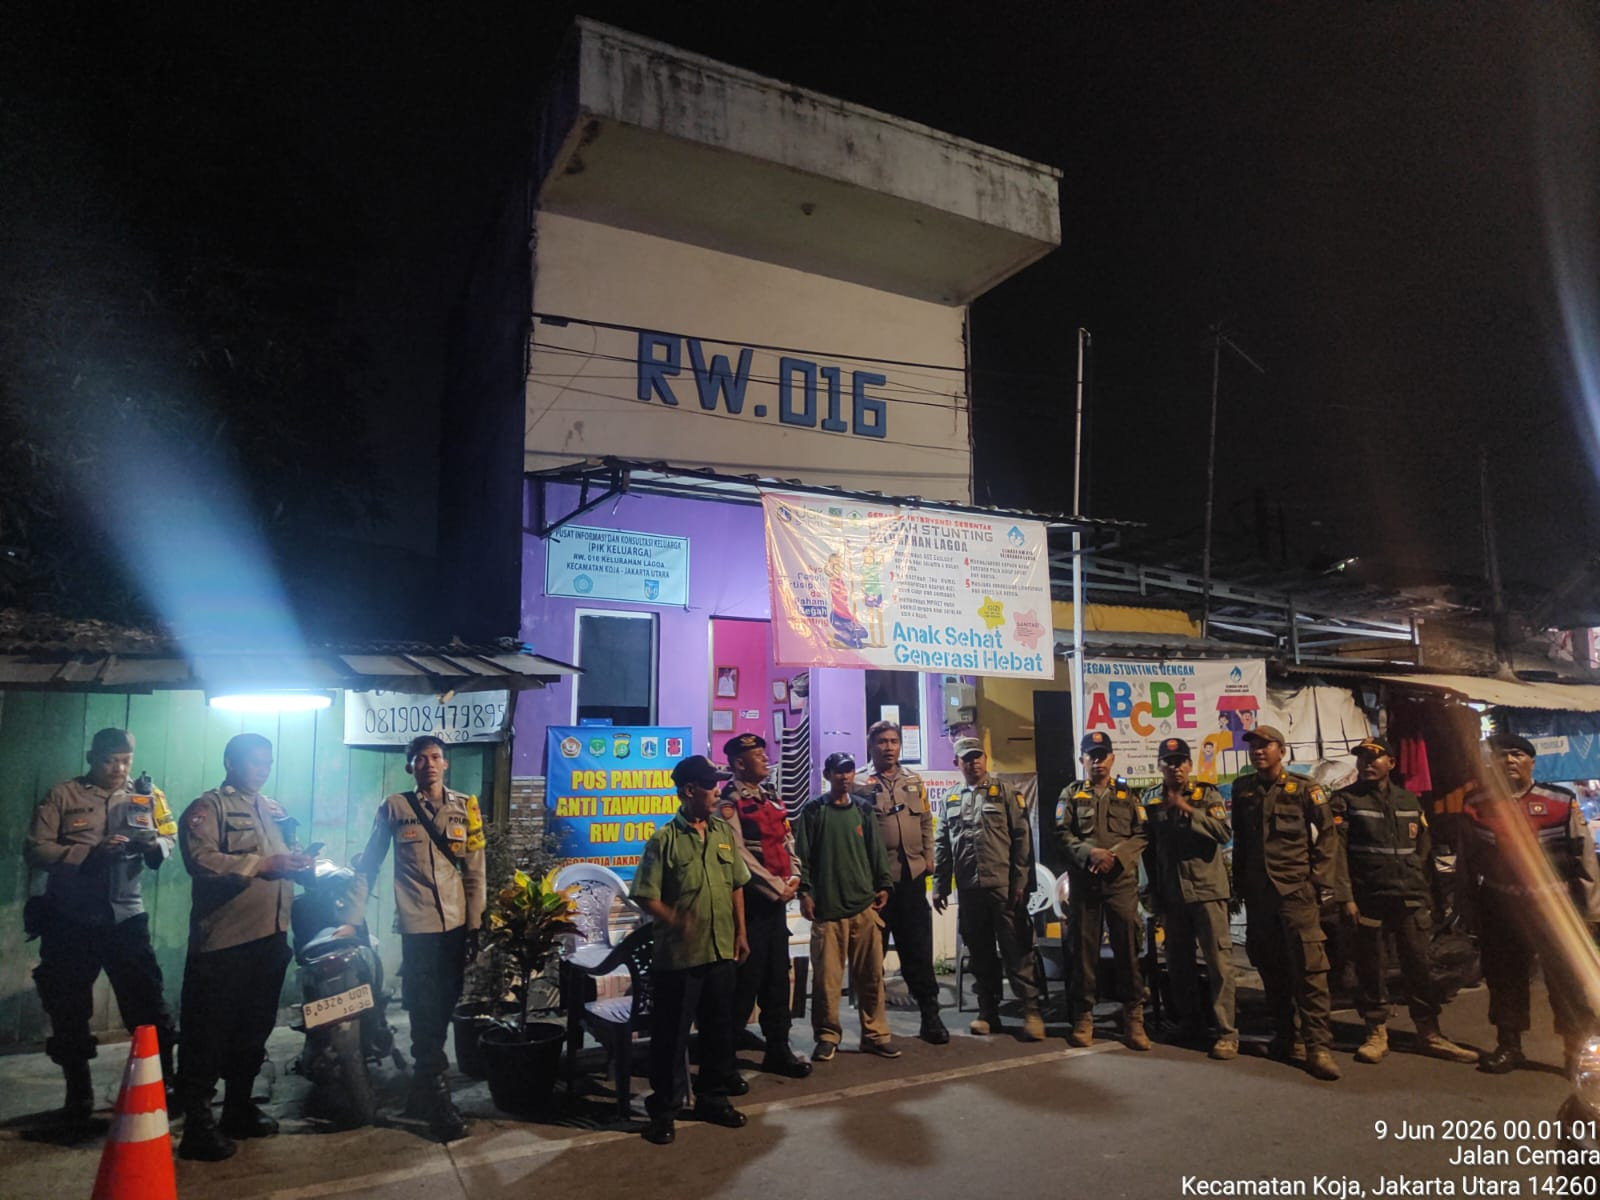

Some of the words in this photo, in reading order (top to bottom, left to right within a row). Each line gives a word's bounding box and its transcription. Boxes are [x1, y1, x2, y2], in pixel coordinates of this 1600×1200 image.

[637, 331, 888, 439] RW.016
[555, 529, 574, 538] PUSAT
[574, 531, 607, 541] INFORMASI
[607, 534, 620, 543] DAN
[620, 535, 653, 547] KONSULTASI
[653, 539, 682, 549] KELUARGA
[921, 524, 993, 542] STUNTING
[588, 542, 605, 553] (PIK
[607, 544, 652, 558] KELUARGA)
[934, 537, 969, 553] LAGOA
[566, 561, 604, 572] KECAMATAN
[604, 565, 620, 574] KOJA
[624, 567, 650, 577] JAKARTA
[650, 570, 670, 578] UTARA
[602, 556, 642, 566] KELURAHAN
[643, 560, 665, 568] LAGOA
[893, 621, 942, 645] Anak
[945, 626, 1003, 649] Sehat
[894, 644, 979, 669] Generasi
[983, 650, 1043, 672] Hebat
[1113, 664, 1159, 675] STUNTING
[1159, 664, 1196, 676] DENGAN
[1086, 681, 1198, 737] ABCDE
[571, 769, 608, 790] POS
[610, 769, 676, 790] PANTAU
[555, 796, 598, 817] ANTI
[589, 822, 621, 843] RW
[623, 821, 656, 842] 016
